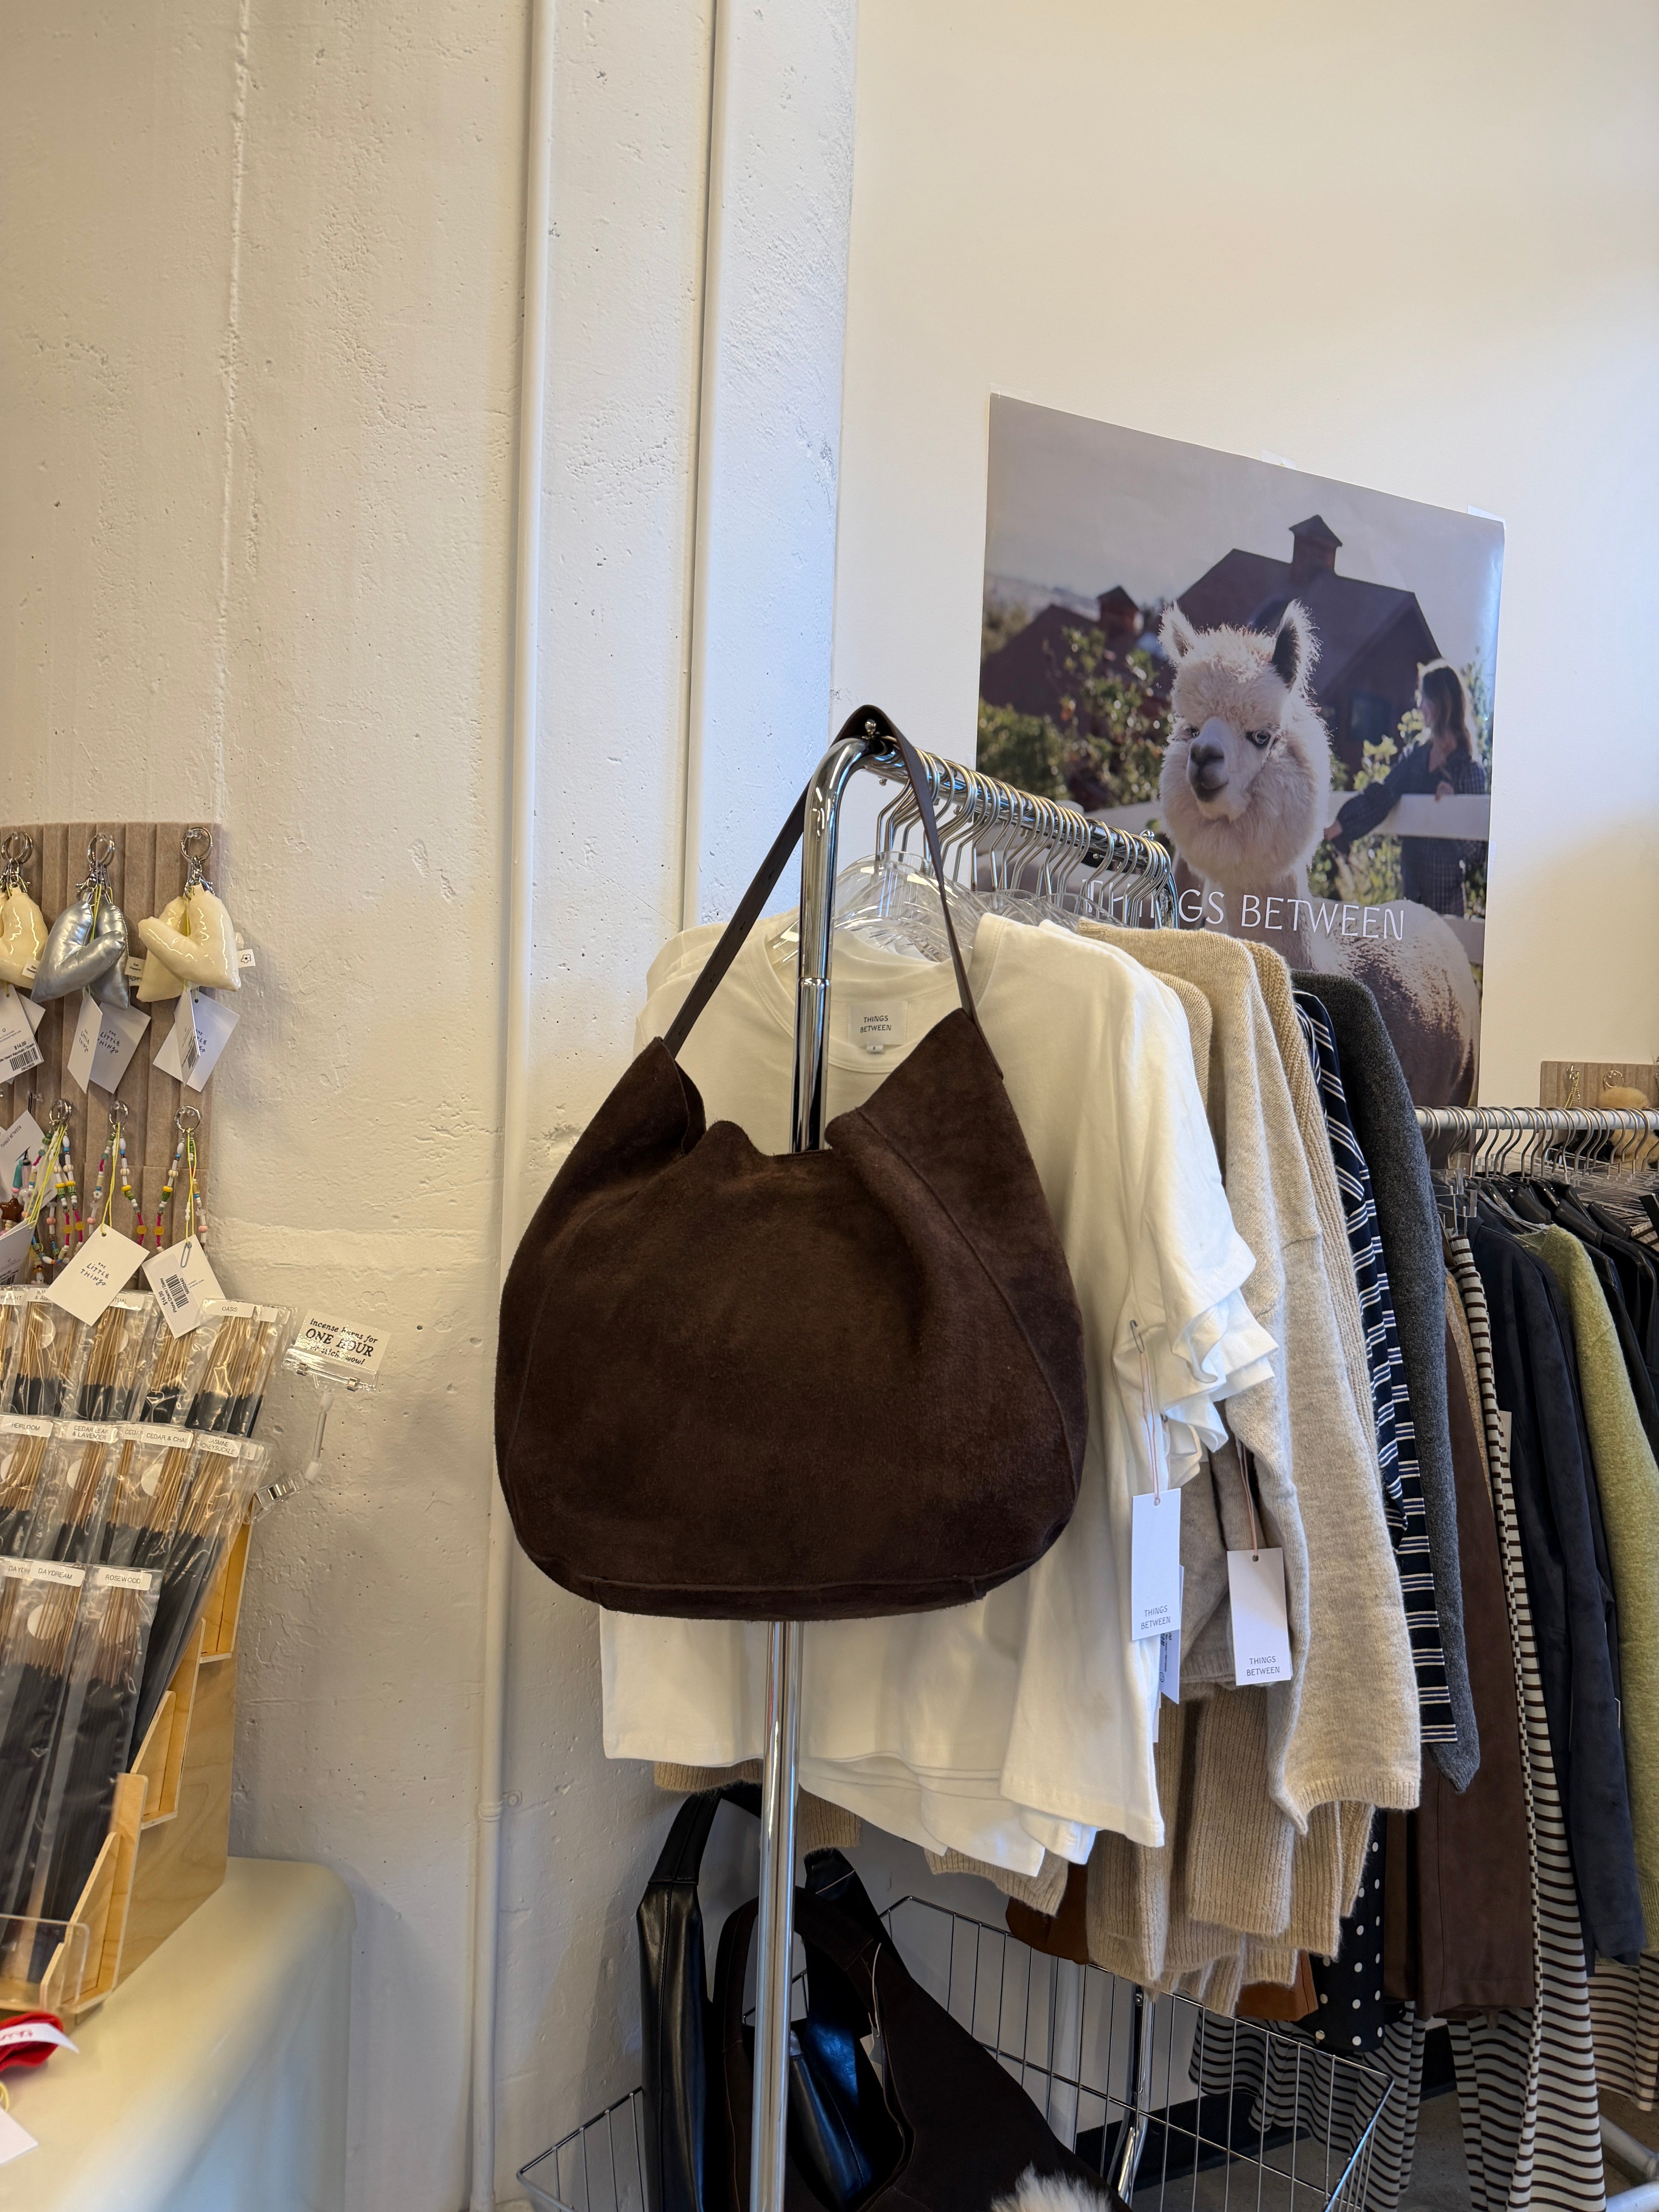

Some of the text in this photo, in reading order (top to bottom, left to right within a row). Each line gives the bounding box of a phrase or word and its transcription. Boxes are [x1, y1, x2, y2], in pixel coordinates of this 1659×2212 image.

[1241, 894, 1404, 941] BETWEEN
[860, 1024, 891, 1033] BETWEEN
[14, 1041, 27, 1050] $14.00
[158, 1291, 168, 1305] $14.00
[306, 1328, 334, 1344] ONE
[310, 1318, 339, 1333] incense
[364, 1335, 378, 1344] for
[11, 1422, 40, 1431] HEIRLOOM
[78, 1432, 107, 1440] LAVENDER
[208, 1438, 230, 1448] JASMINE
[202, 1443, 235, 1455] ONEYSUCKLE
[38, 1568, 73, 1580] DAYDREAM
[105, 1574, 141, 1584] ROSEWOOD
[1144, 1605, 1168, 1618] THINGS
[1141, 1616, 1171, 1630] BETWEEN
[1249, 1656, 1276, 1664] THINGS
[1247, 1666, 1280, 1676] BETWEEN
